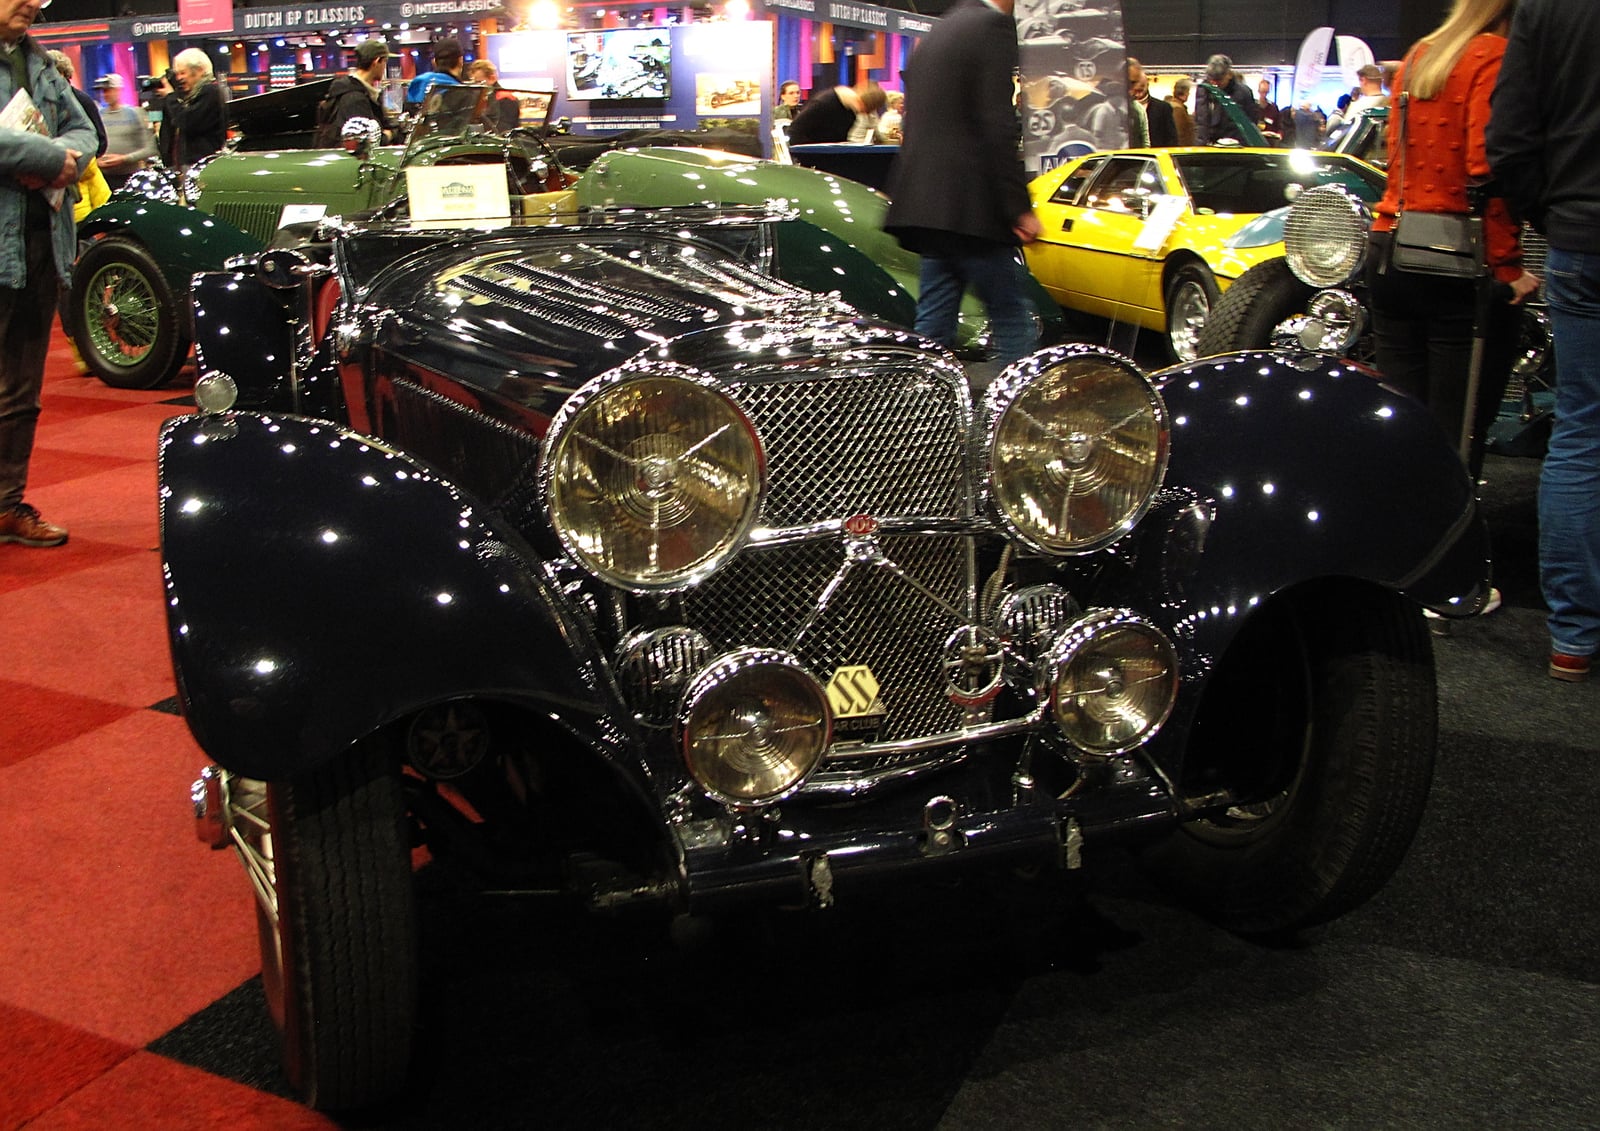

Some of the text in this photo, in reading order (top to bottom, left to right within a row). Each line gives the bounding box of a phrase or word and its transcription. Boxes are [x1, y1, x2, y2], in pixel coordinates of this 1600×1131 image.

[244, 5, 365, 28] DUTCH GP CLASSICS
[145, 21, 180, 33] INTERCL
[832, 669, 873, 714] SS
[850, 717, 880, 730] CLUB
